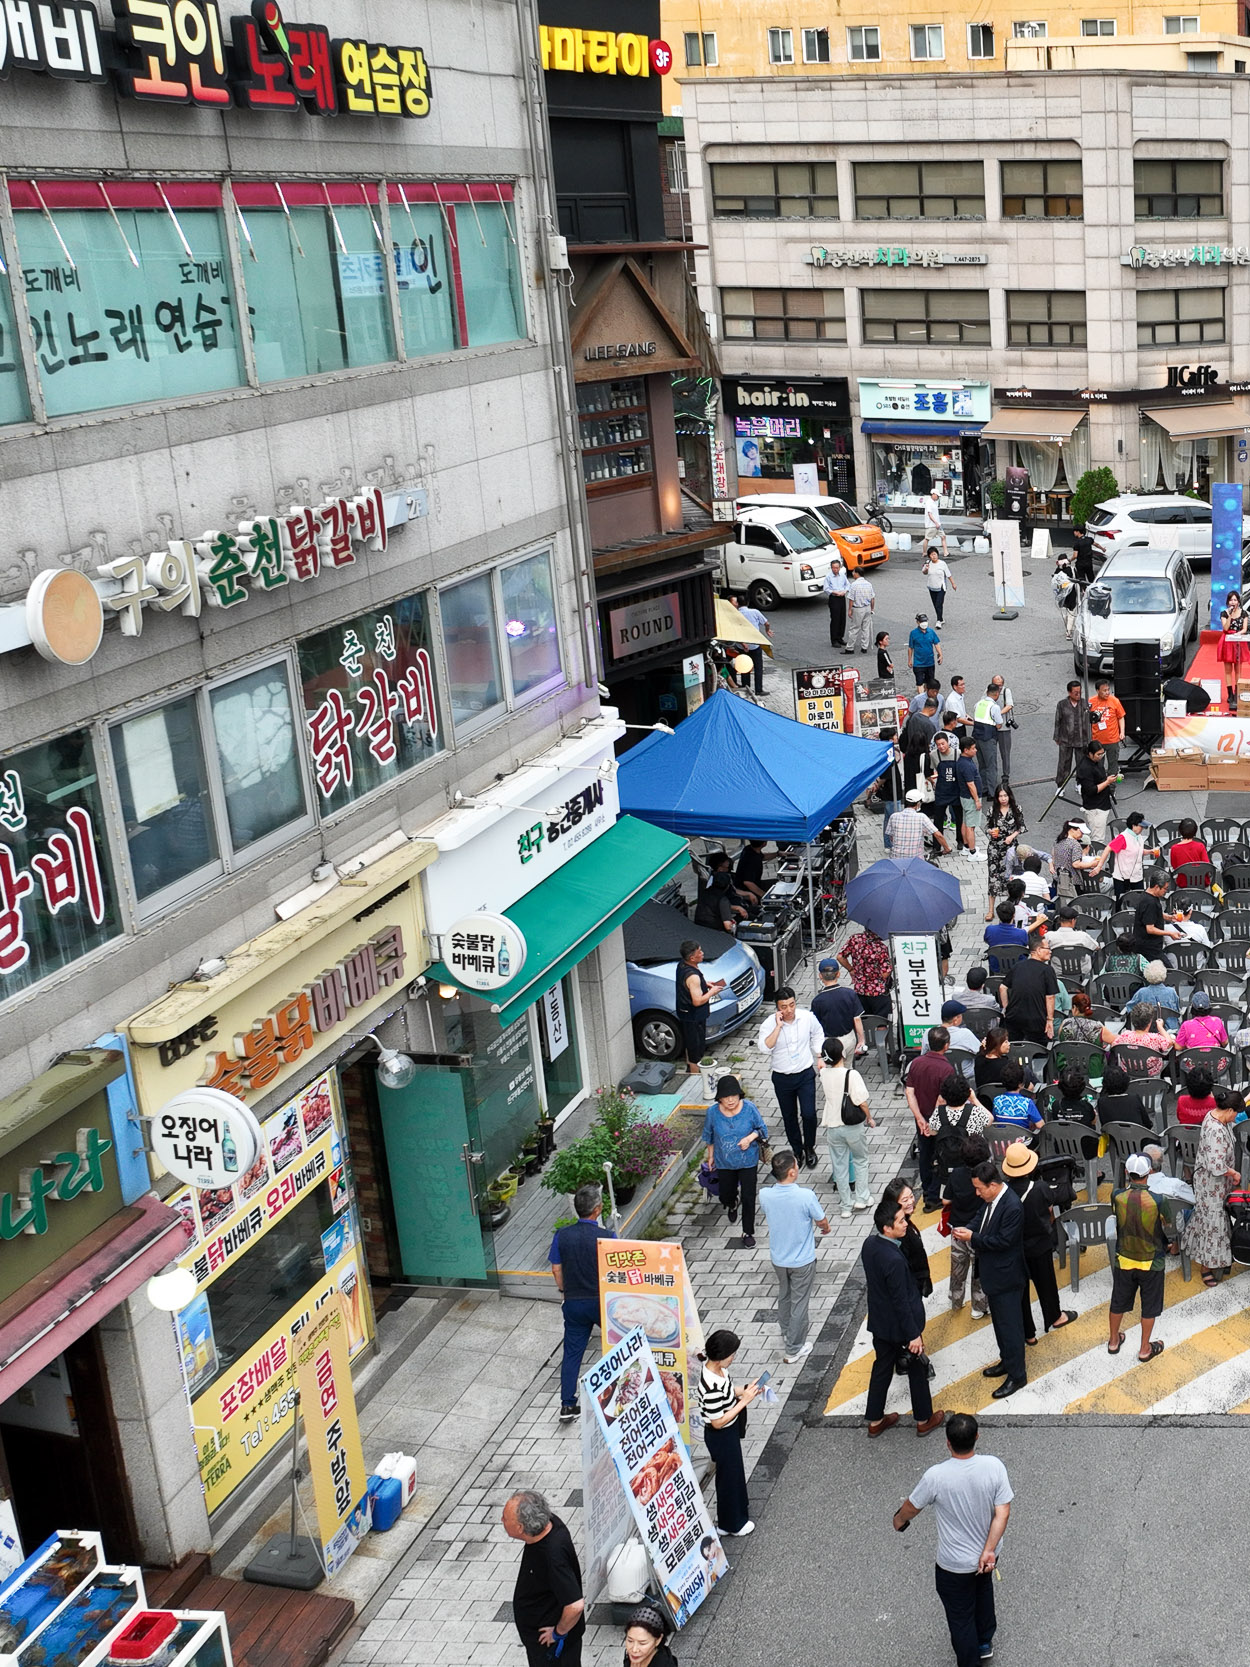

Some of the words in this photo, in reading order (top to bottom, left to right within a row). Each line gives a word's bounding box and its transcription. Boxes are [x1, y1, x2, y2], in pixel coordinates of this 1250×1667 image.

[127, 0, 230, 104] 코인
[246, 20, 337, 111] 노래
[341, 39, 431, 117] 연습장
[655, 48, 670, 67] 3F
[24, 267, 81, 294] 도깨비
[179, 261, 225, 286] 도깨비
[616, 341, 657, 357] SANG
[914, 391, 949, 414] 조흥
[98, 540, 200, 637] 구의
[620, 615, 674, 645] ROUND
[307, 646, 438, 798] 닭갈비
[808, 711, 834, 722] 아로마
[517, 821, 545, 865] 친구
[451, 931, 495, 953] 숯불닭
[901, 942, 928, 955] 친구
[452, 952, 496, 974] 바베큐
[908, 959, 931, 1017] 부동산
[161, 1114, 220, 1144] 오징어
[173, 1143, 213, 1171] 나라
[0, 1127, 113, 1241] 나라
[606, 1250, 647, 1268] 더맛존
[607, 1271, 627, 1284] 숯불
[628, 1270, 643, 1285] 닭
[644, 1272, 676, 1287] 바베큐
[219, 1334, 289, 1423] 포장배달
[587, 1331, 644, 1394] 오징어나라
[617, 1392, 652, 1433] 전어회
[240, 1430, 264, 1456] Tel
[618, 1403, 663, 1456] 전어무침
[624, 1419, 668, 1471] 전어구이
[204, 1456, 232, 1488] TERRA
[645, 1470, 686, 1521] 생새우찜
[646, 1481, 697, 1545] 생새우튀김
[658, 1505, 698, 1554] 생새우회
[680, 1570, 706, 1610] KRUSH
